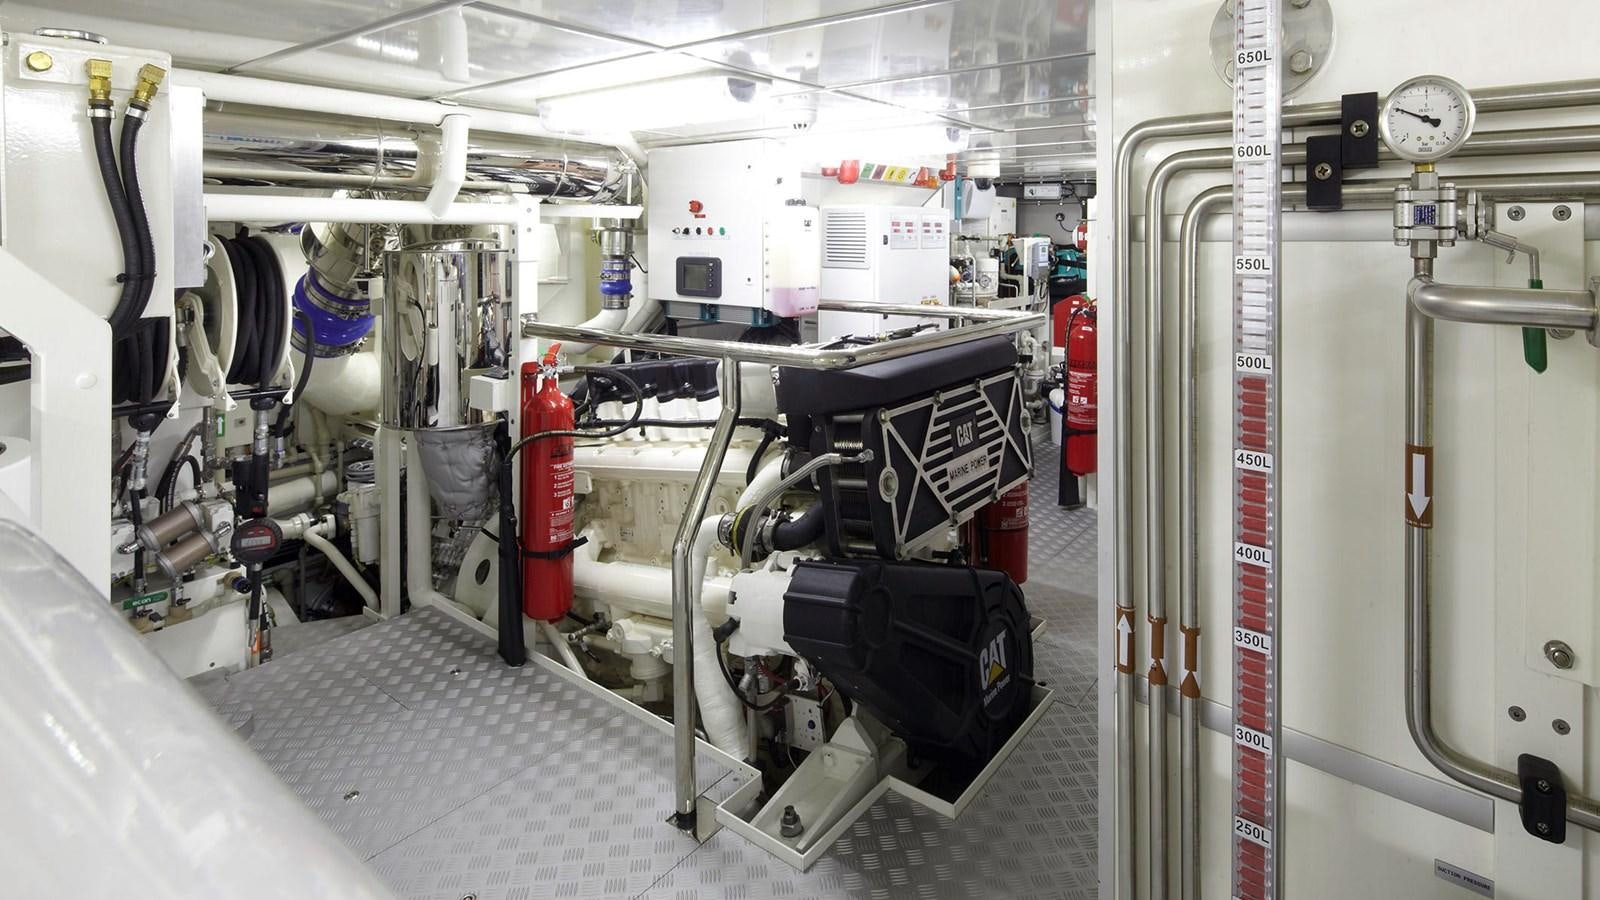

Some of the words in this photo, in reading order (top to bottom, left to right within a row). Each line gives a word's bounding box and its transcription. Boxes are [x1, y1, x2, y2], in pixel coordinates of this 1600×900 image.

[1238, 50, 1272, 64] 650L
[1238, 144, 1271, 157] 600L
[1236, 258, 1270, 270] 550L
[1237, 356, 1271, 369] 500L
[956, 421, 973, 447] CAT
[949, 463, 969, 481] MARINE
[970, 454, 987, 470] POWER
[1237, 452, 1271, 469] 450L
[1236, 546, 1270, 564] 400L
[1235, 631, 1269, 650] 350L
[980, 628, 1007, 690] CAT
[1236, 728, 1270, 750] 300L
[1235, 819, 1270, 844] 250L
[1437, 866, 1461, 879] SUCTION
[1463, 876, 1490, 890] PRESSURE
